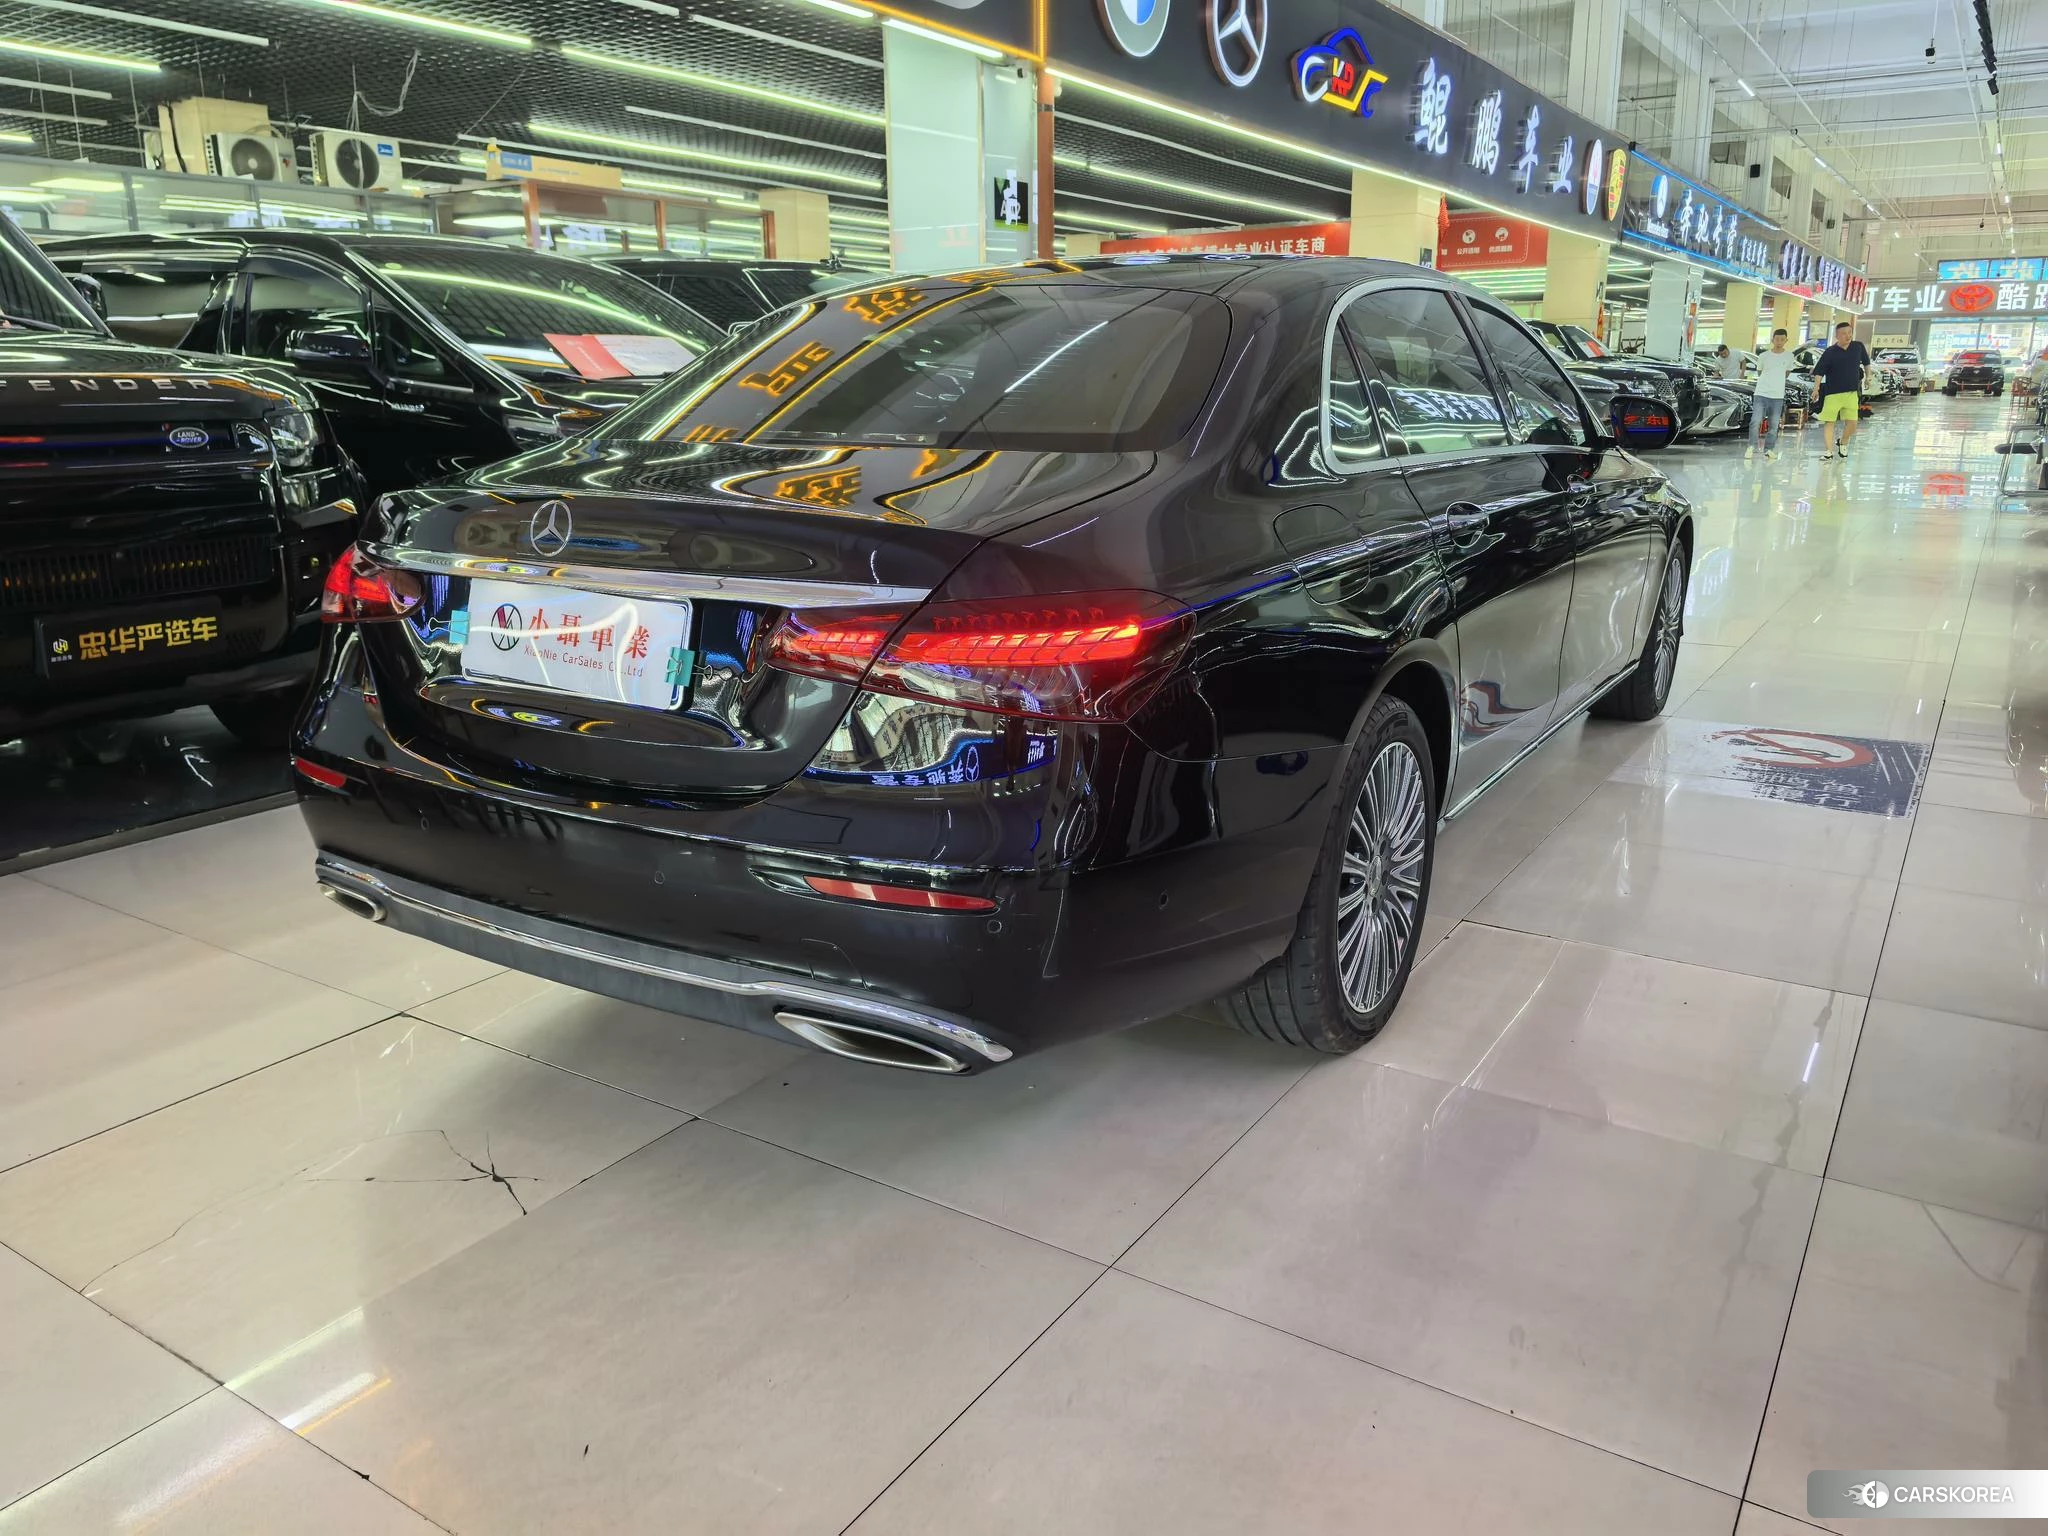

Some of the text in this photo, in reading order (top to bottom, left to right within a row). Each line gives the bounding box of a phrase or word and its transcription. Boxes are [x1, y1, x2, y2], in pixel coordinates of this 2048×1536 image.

[1413, 56, 1574, 194] 鲲鹏车业
[0, 378, 214, 392] ENDER
[177, 430, 196, 438] LAND
[180, 436, 202, 444] ROVER
[78, 616, 218, 661] 忠华严选车
[562, 651, 603, 670] CarSales
